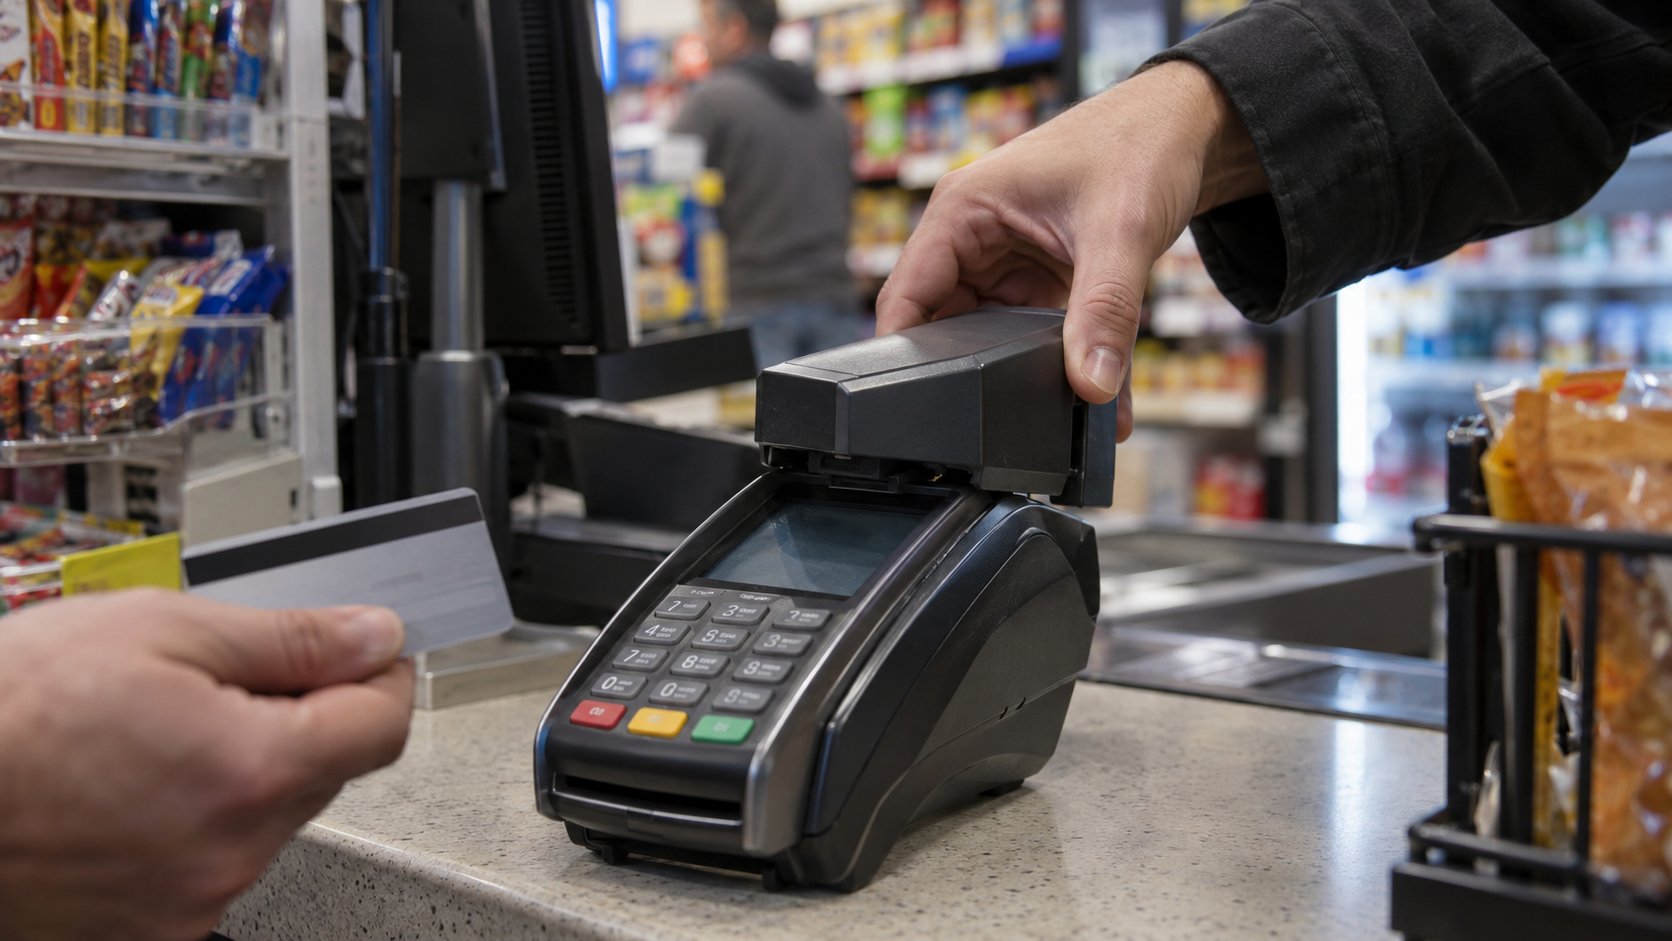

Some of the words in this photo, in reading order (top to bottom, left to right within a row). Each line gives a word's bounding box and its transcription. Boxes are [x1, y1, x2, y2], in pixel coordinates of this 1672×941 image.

[644, 624, 660, 637] 4
[623, 649, 640, 662] 7
[681, 655, 698, 669] 8
[601, 676, 618, 690] 0
[660, 682, 678, 697] 0
